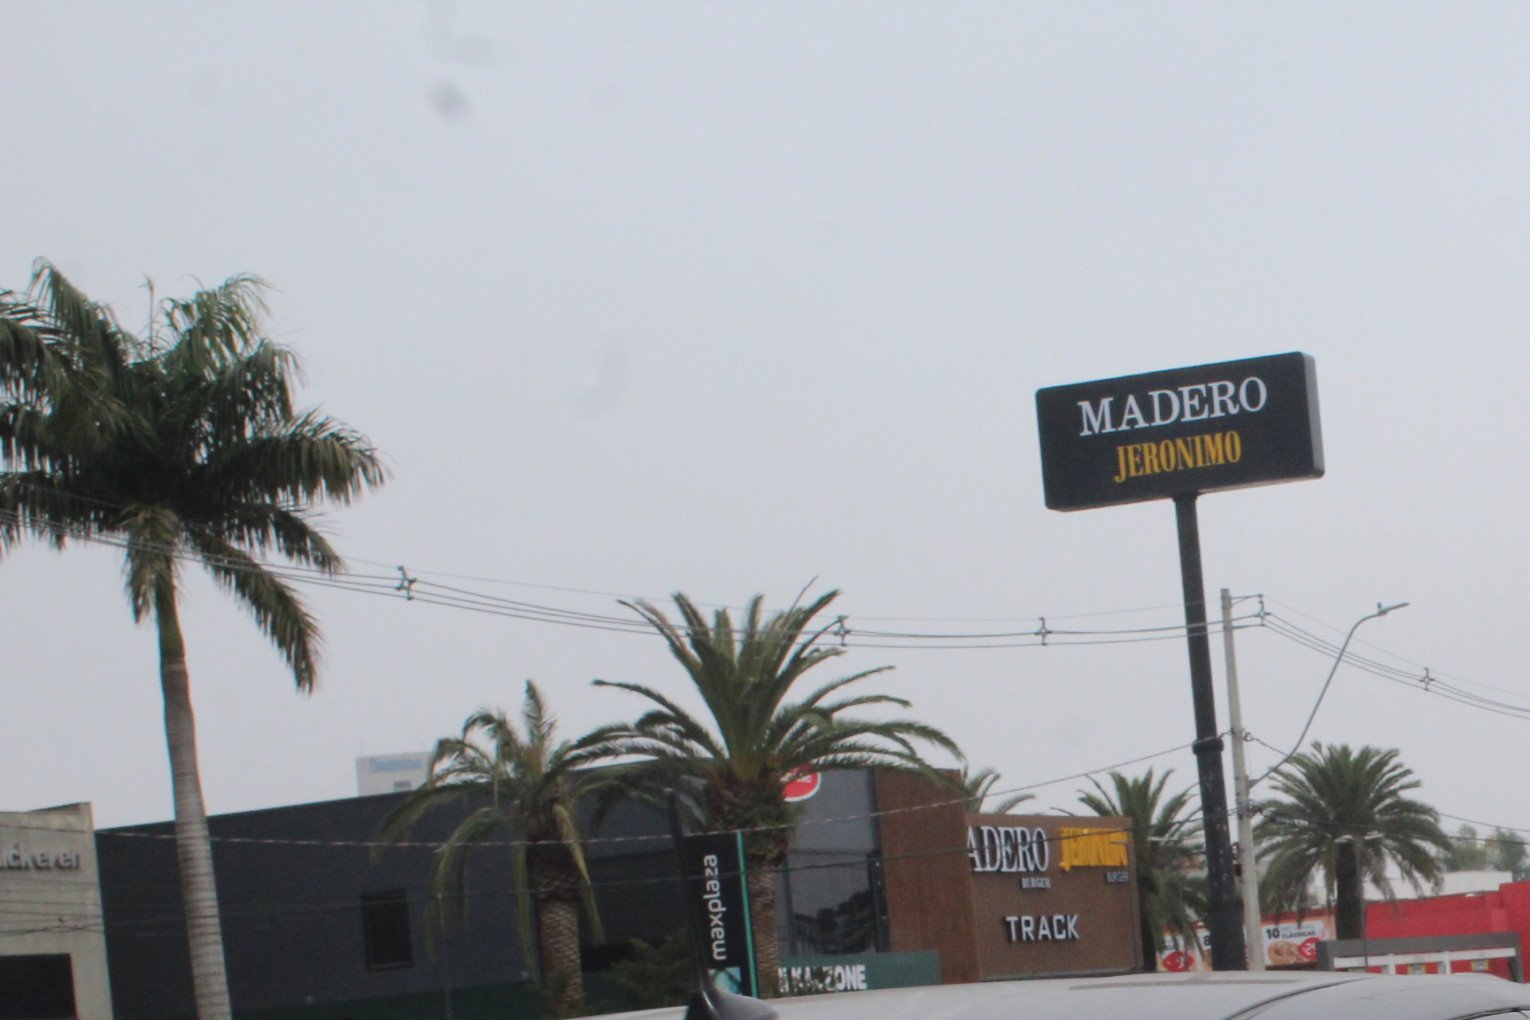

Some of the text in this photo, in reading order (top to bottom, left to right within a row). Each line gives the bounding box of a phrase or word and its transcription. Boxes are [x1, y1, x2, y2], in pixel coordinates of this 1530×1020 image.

[1077, 376, 1268, 436] MADERO
[1113, 430, 1242, 483] JERONIMO
[703, 854, 727, 961] maxplaza
[1005, 914, 1080, 941] TRACK
[1266, 928, 1280, 939] 10
